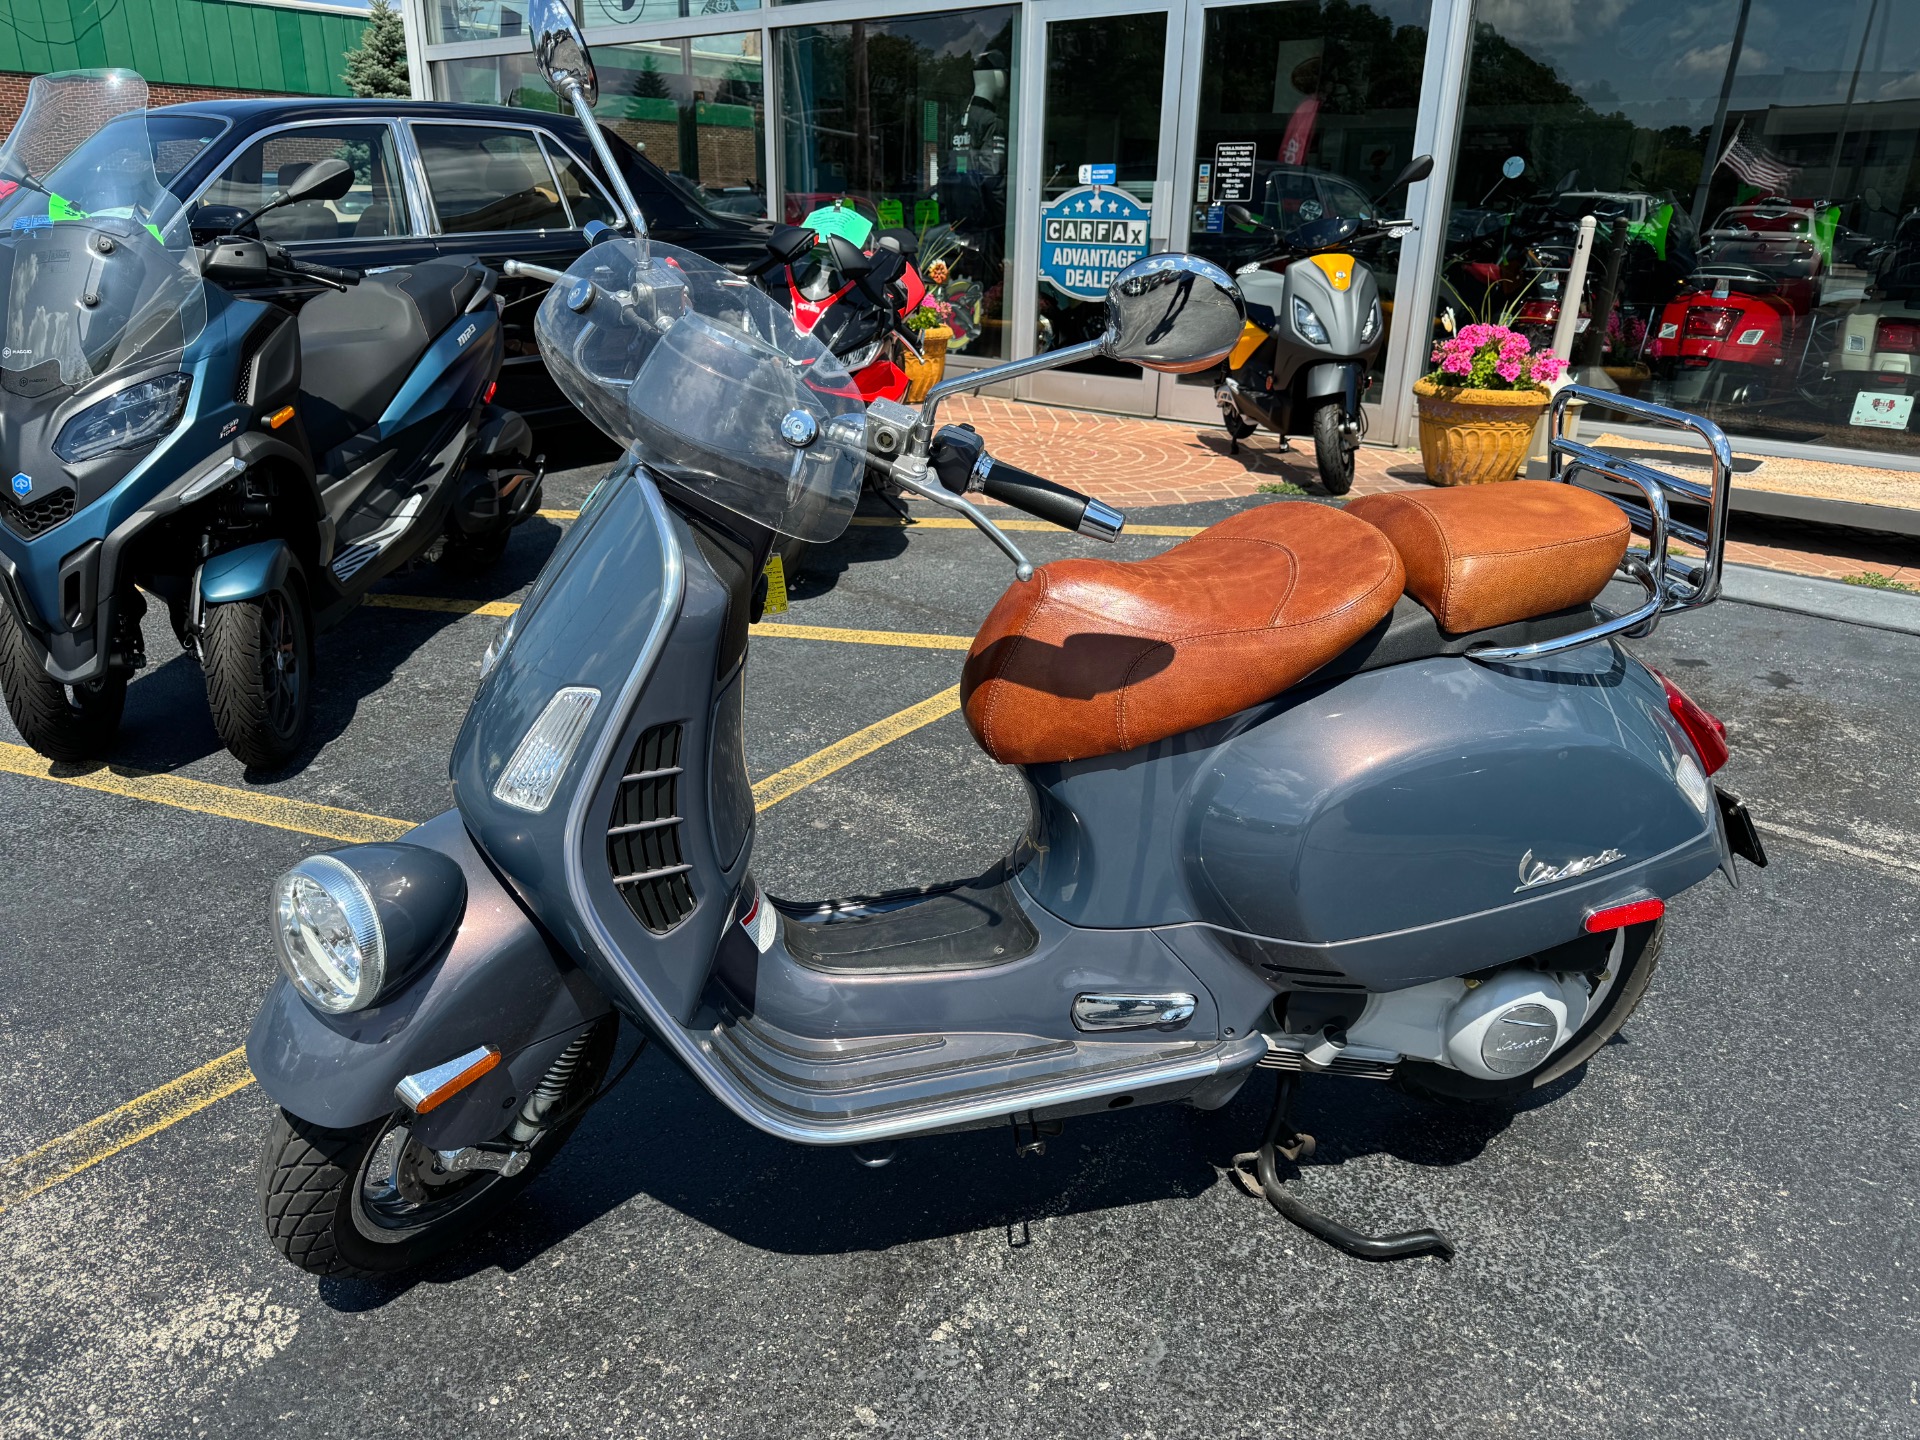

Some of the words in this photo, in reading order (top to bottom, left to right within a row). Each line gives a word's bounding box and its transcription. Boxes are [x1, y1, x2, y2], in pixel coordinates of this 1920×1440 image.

[1049, 222, 1143, 244] CARFAX
[797, 302, 820, 314] aprilia
[456, 323, 476, 346] MP3
[1513, 848, 1627, 893] Vespa
[1496, 1032, 1550, 1052] Vespa
